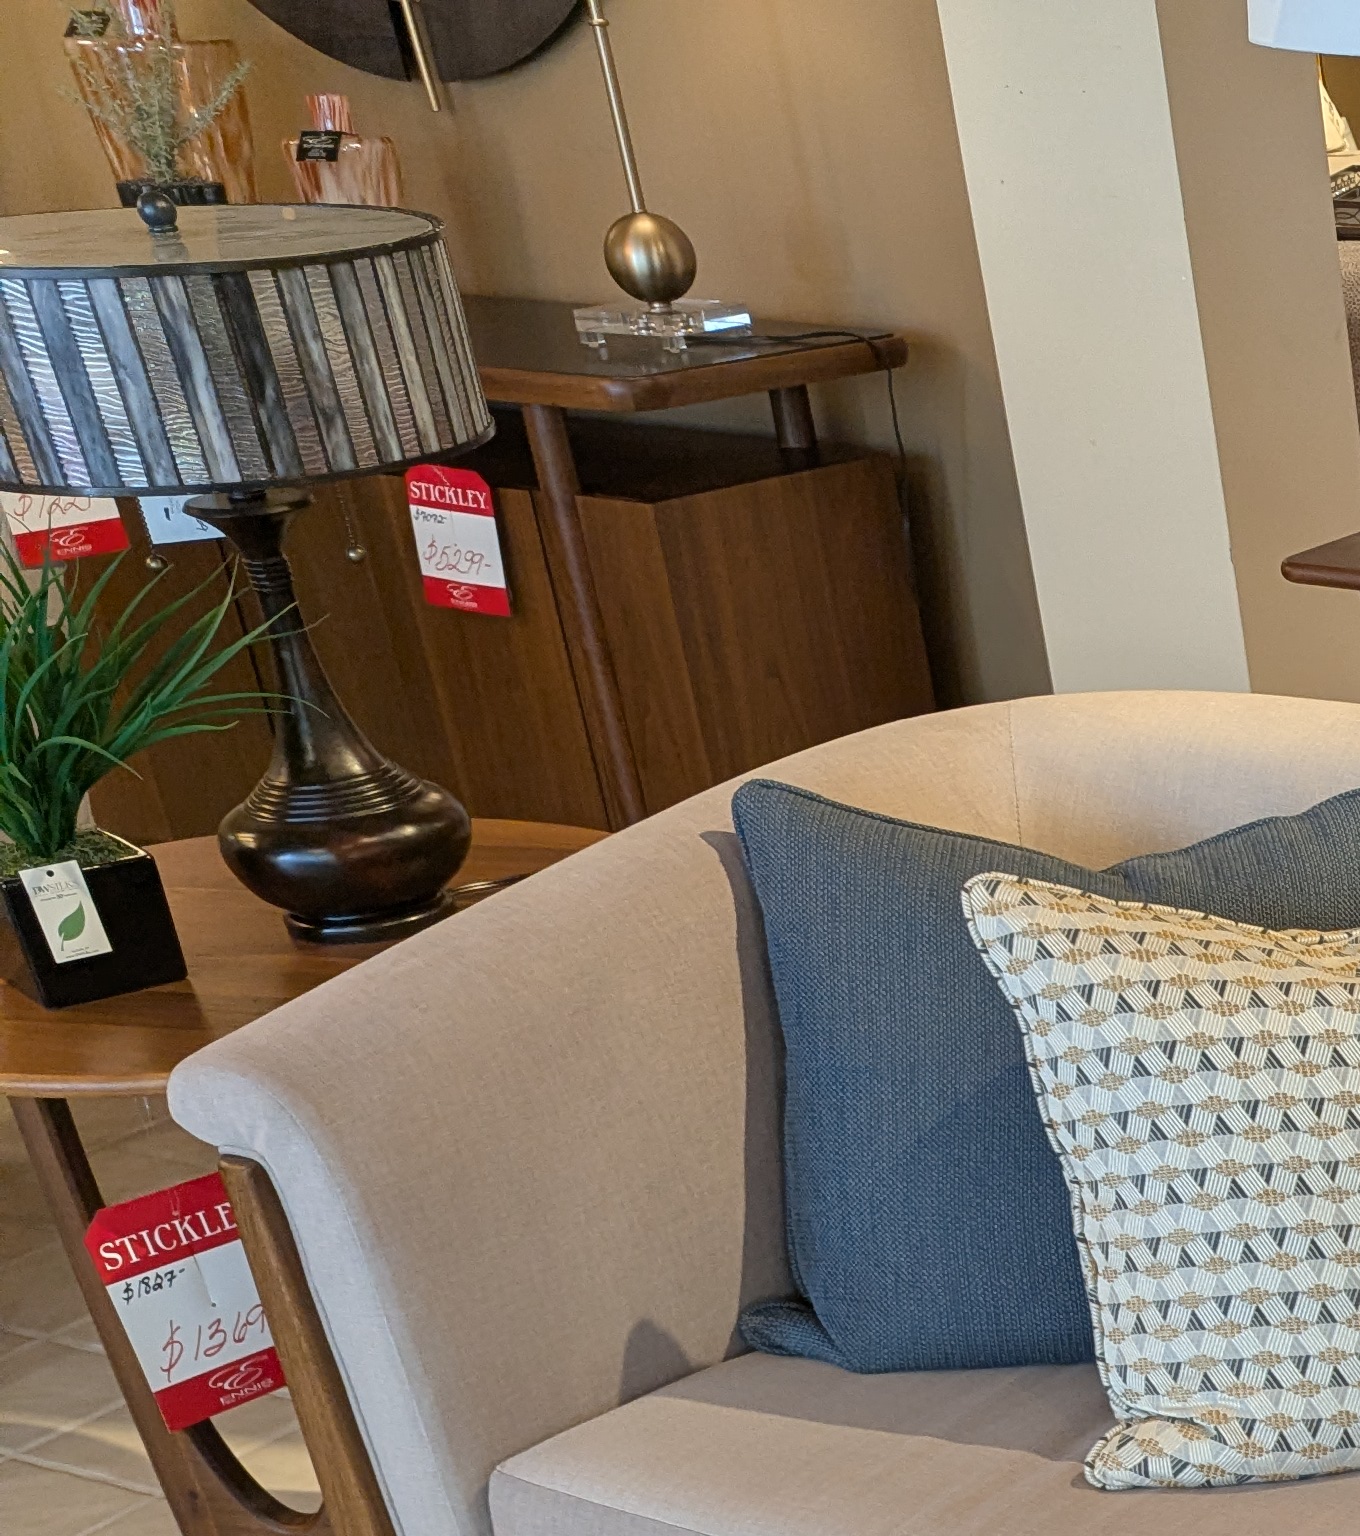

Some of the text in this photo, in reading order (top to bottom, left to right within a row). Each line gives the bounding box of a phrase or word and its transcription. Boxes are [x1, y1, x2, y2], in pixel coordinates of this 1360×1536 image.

[410, 481, 487, 509] STICKLEY
[100, 1202, 238, 1271] STICKLE
[220, 1378, 274, 1405] ENNIS
